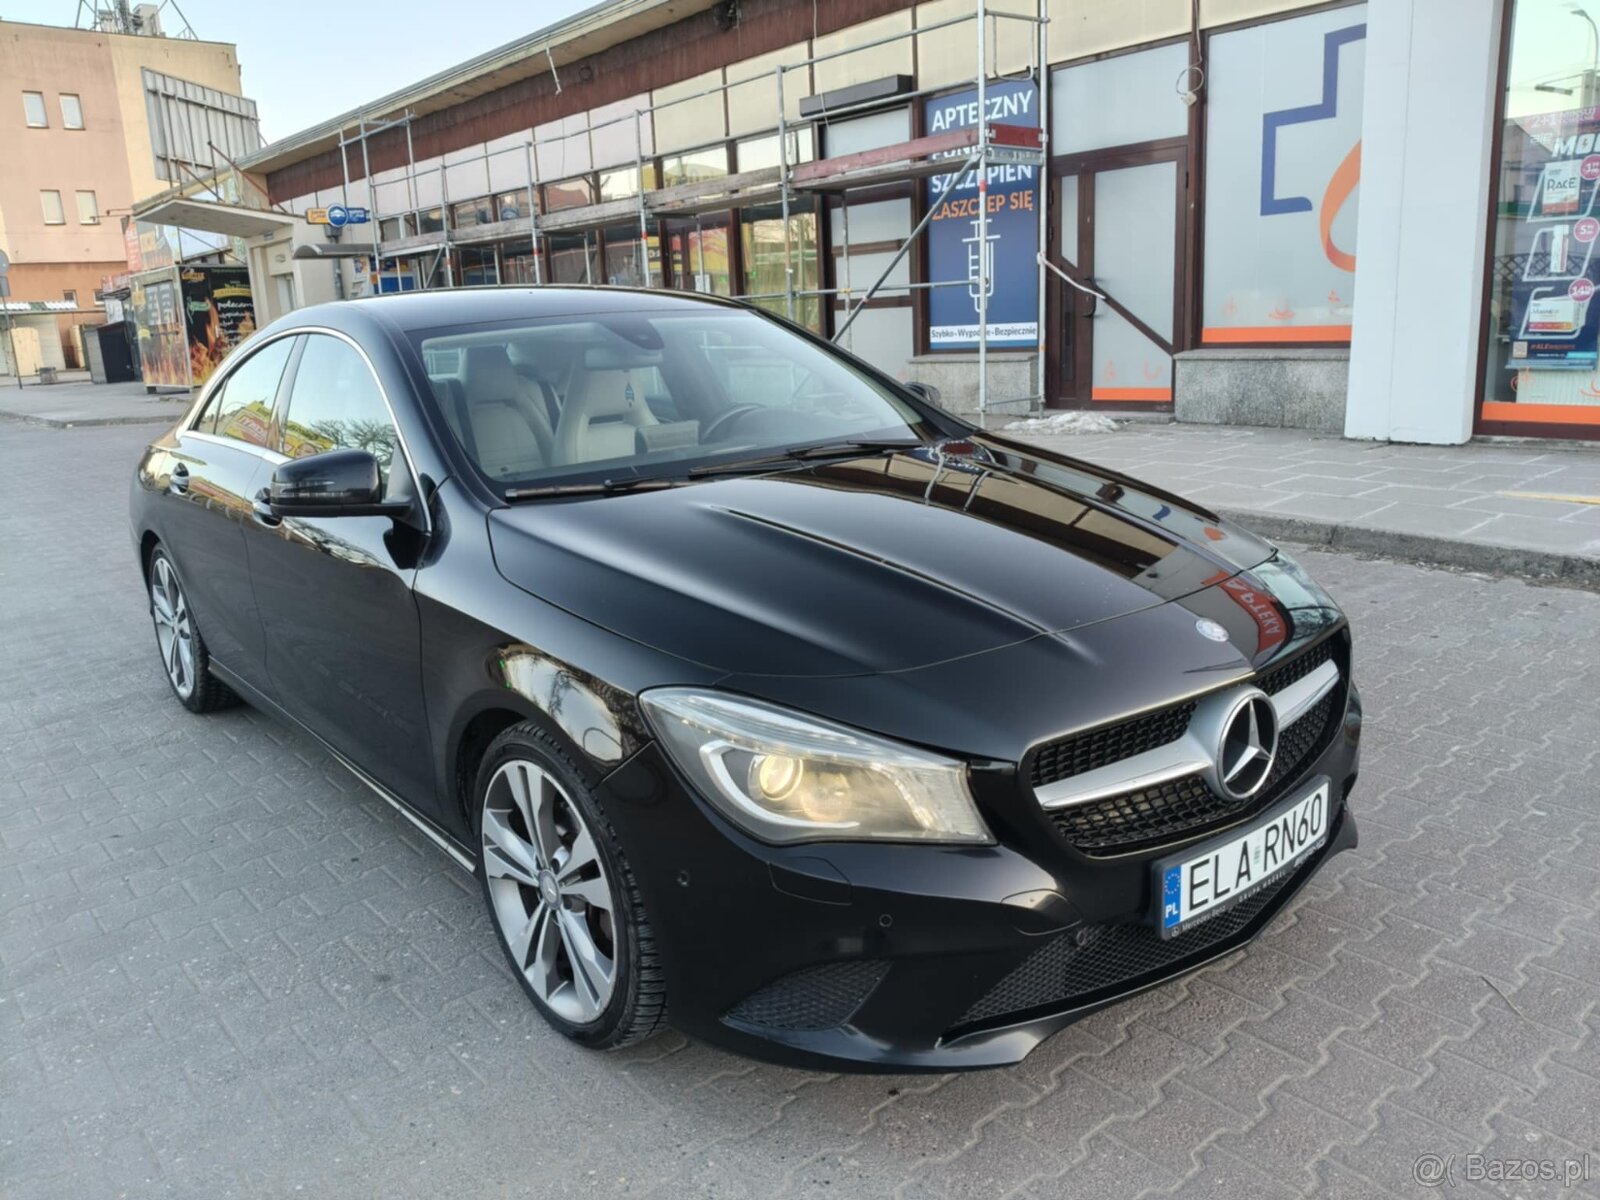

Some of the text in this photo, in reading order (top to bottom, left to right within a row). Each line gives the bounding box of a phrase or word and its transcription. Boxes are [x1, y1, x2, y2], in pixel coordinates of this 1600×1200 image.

[931, 189, 1033, 220] ASZCEP SIĘ
[931, 328, 954, 339] Szybko
[994, 325, 1036, 337] Bezpiecznie
[1189, 840, 1252, 911] ELA
[1264, 791, 1322, 872] RN60
[1165, 901, 1179, 918] PL
